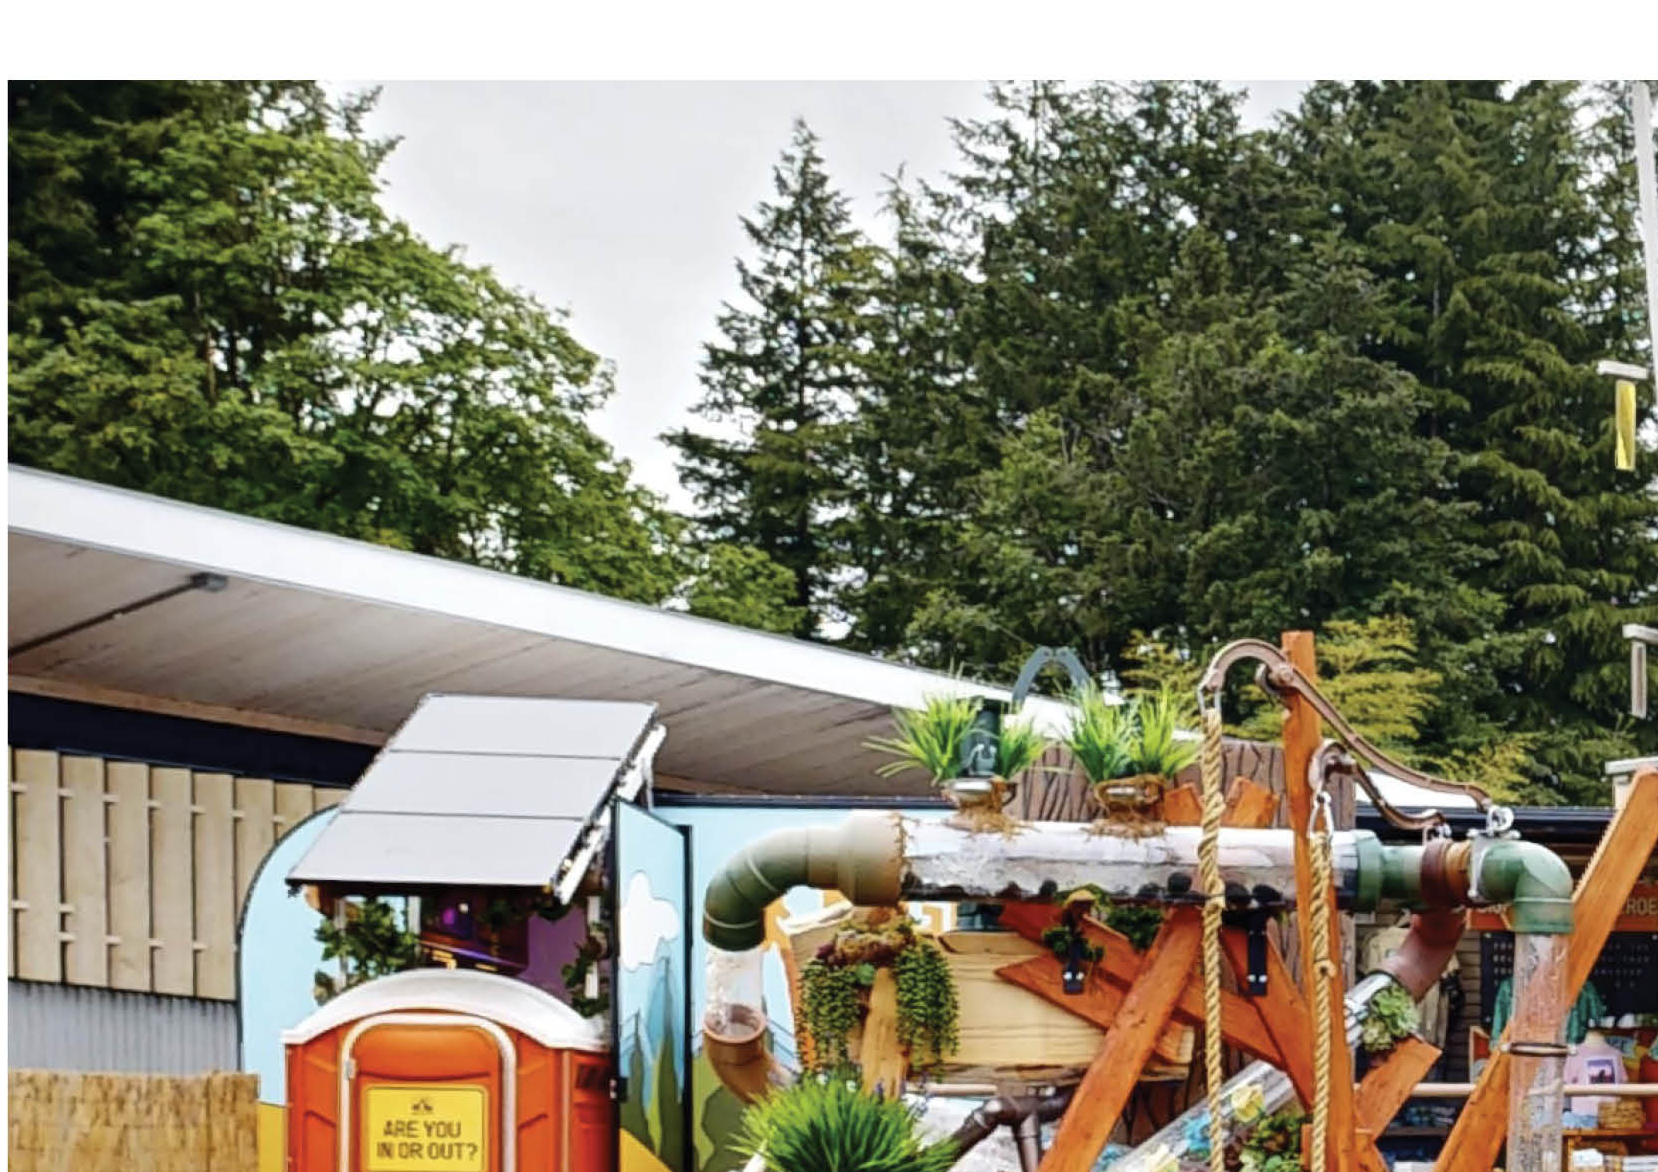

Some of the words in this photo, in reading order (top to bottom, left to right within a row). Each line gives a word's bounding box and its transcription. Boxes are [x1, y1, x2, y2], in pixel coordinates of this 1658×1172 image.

[383, 1120, 420, 1138] ARE
[423, 1121, 462, 1138] YOU
[376, 1142, 393, 1159] IN
[398, 1142, 424, 1159] OR
[427, 1142, 479, 1161] OUT?
